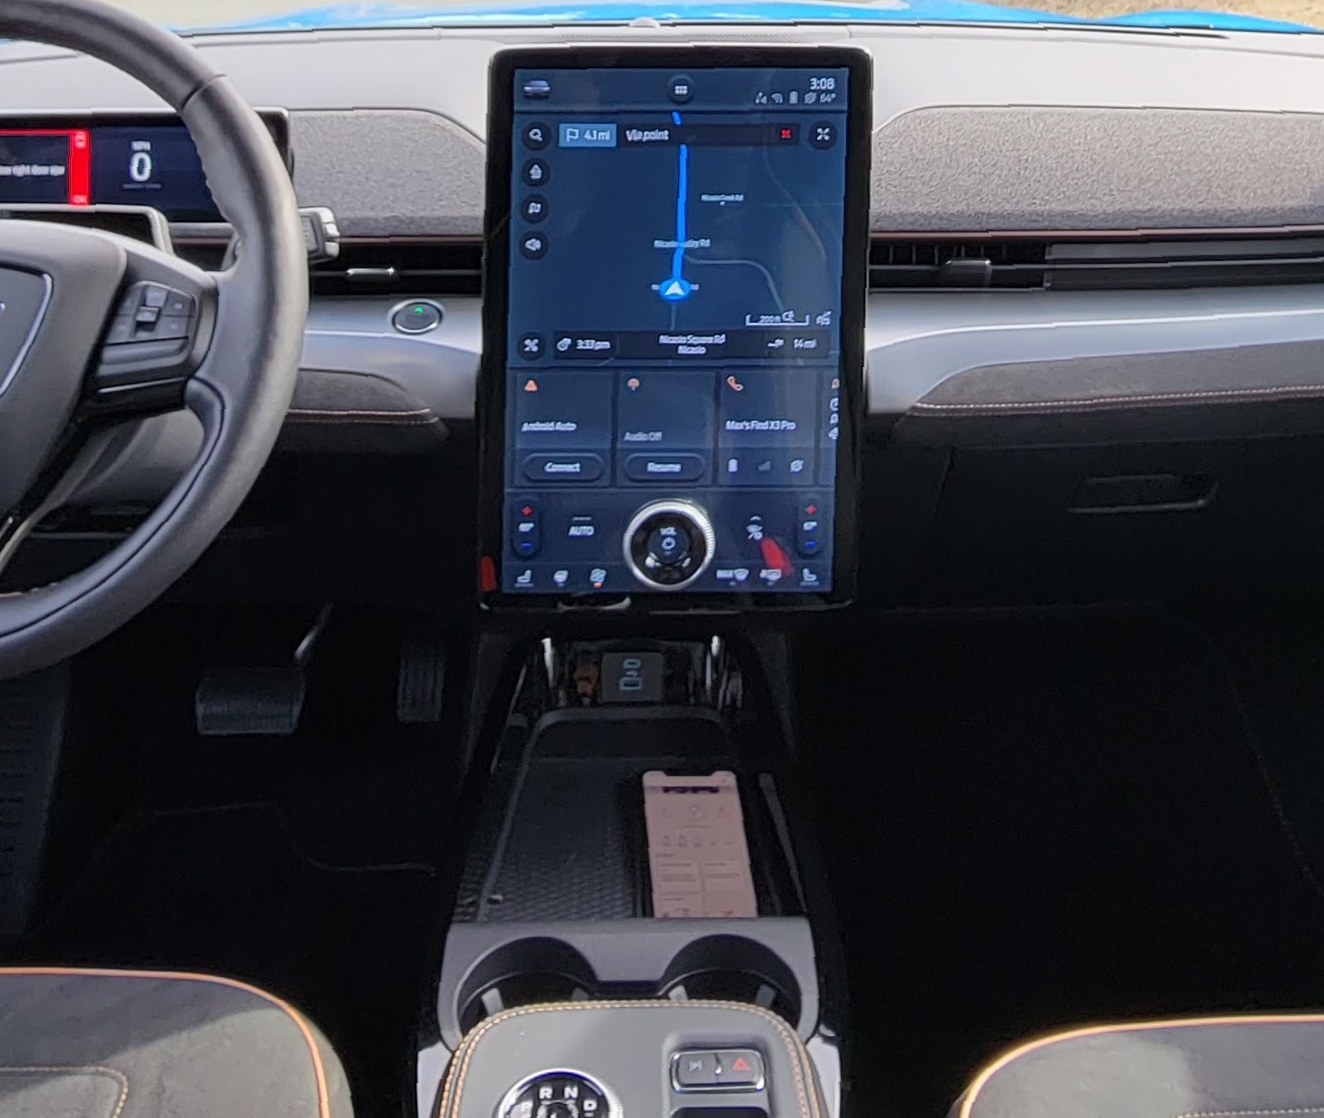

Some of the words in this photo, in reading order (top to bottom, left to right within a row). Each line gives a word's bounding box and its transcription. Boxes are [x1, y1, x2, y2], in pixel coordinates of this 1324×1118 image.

[809, 77, 835, 91] 3:08
[130, 151, 153, 183] 0
[576, 339, 595, 350] 3:33
[594, 340, 611, 351] pm
[713, 333, 727, 345] Rd
[521, 421, 555, 432] Android
[554, 422, 577, 431] Auto
[750, 420, 769, 431] Find
[768, 420, 781, 431] X3
[781, 420, 797, 431] Pro
[623, 431, 650, 442] Audio
[648, 431, 663, 441] Off
[544, 462, 581, 473] Connect
[647, 462, 682, 473] Resume
[568, 525, 595, 537] AUTO
[538, 1085, 553, 1100] R
[563, 1085, 579, 1100] N
[583, 1099, 598, 1112] D
